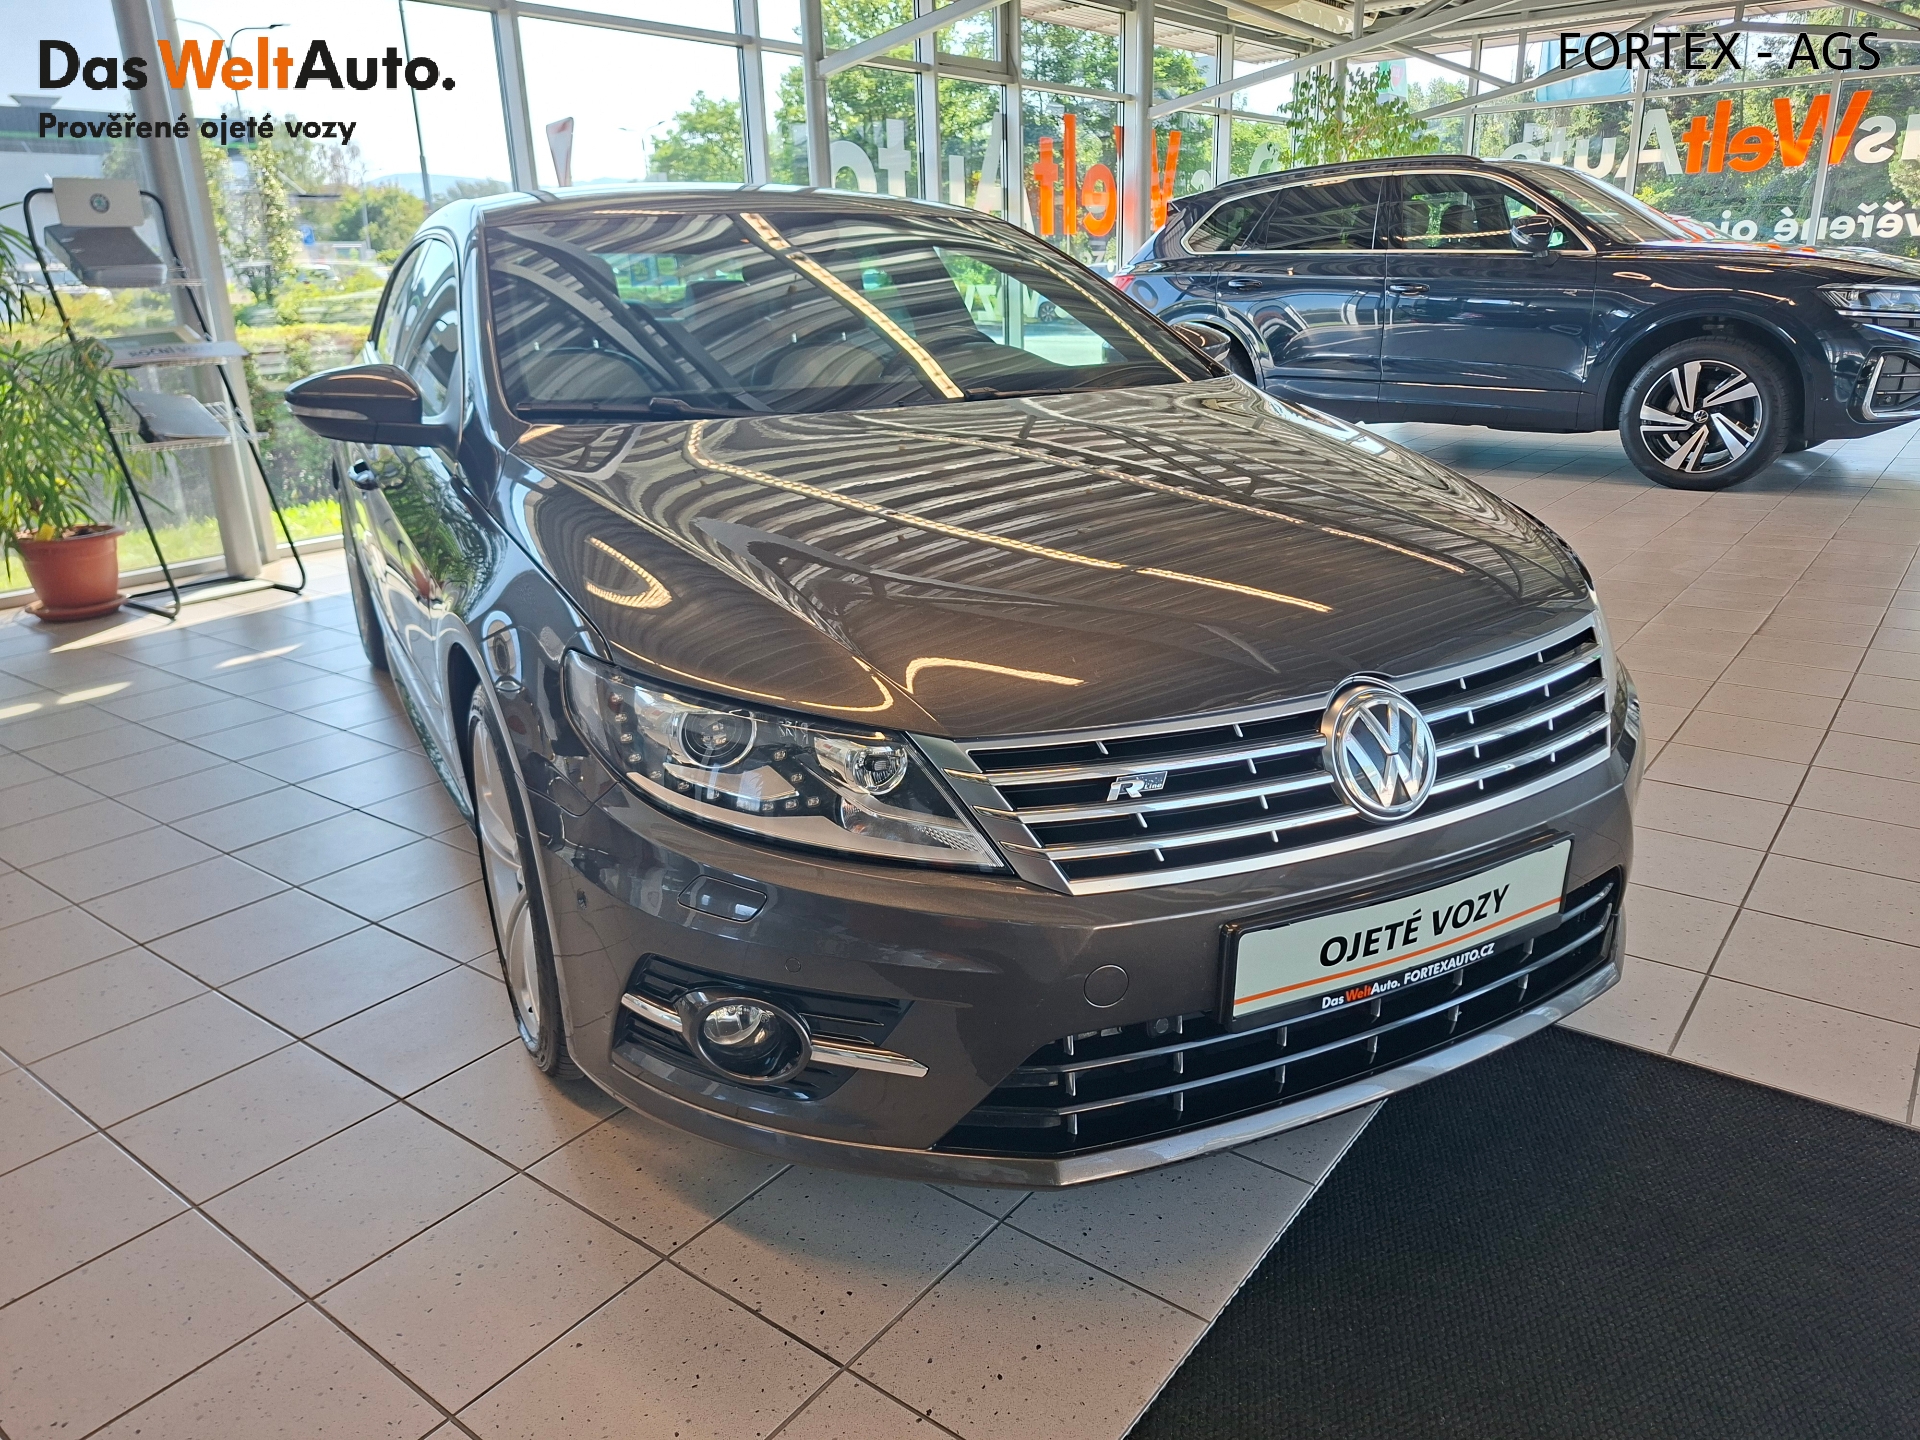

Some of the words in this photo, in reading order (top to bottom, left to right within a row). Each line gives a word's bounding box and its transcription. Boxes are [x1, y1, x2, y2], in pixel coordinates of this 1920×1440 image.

[1319, 909, 1422, 967] OJETÉ
[1432, 883, 1510, 936] VOZY
[1321, 995, 1345, 1010] Das
[1404, 942, 1495, 985] FORTEXAUTO.CZ
